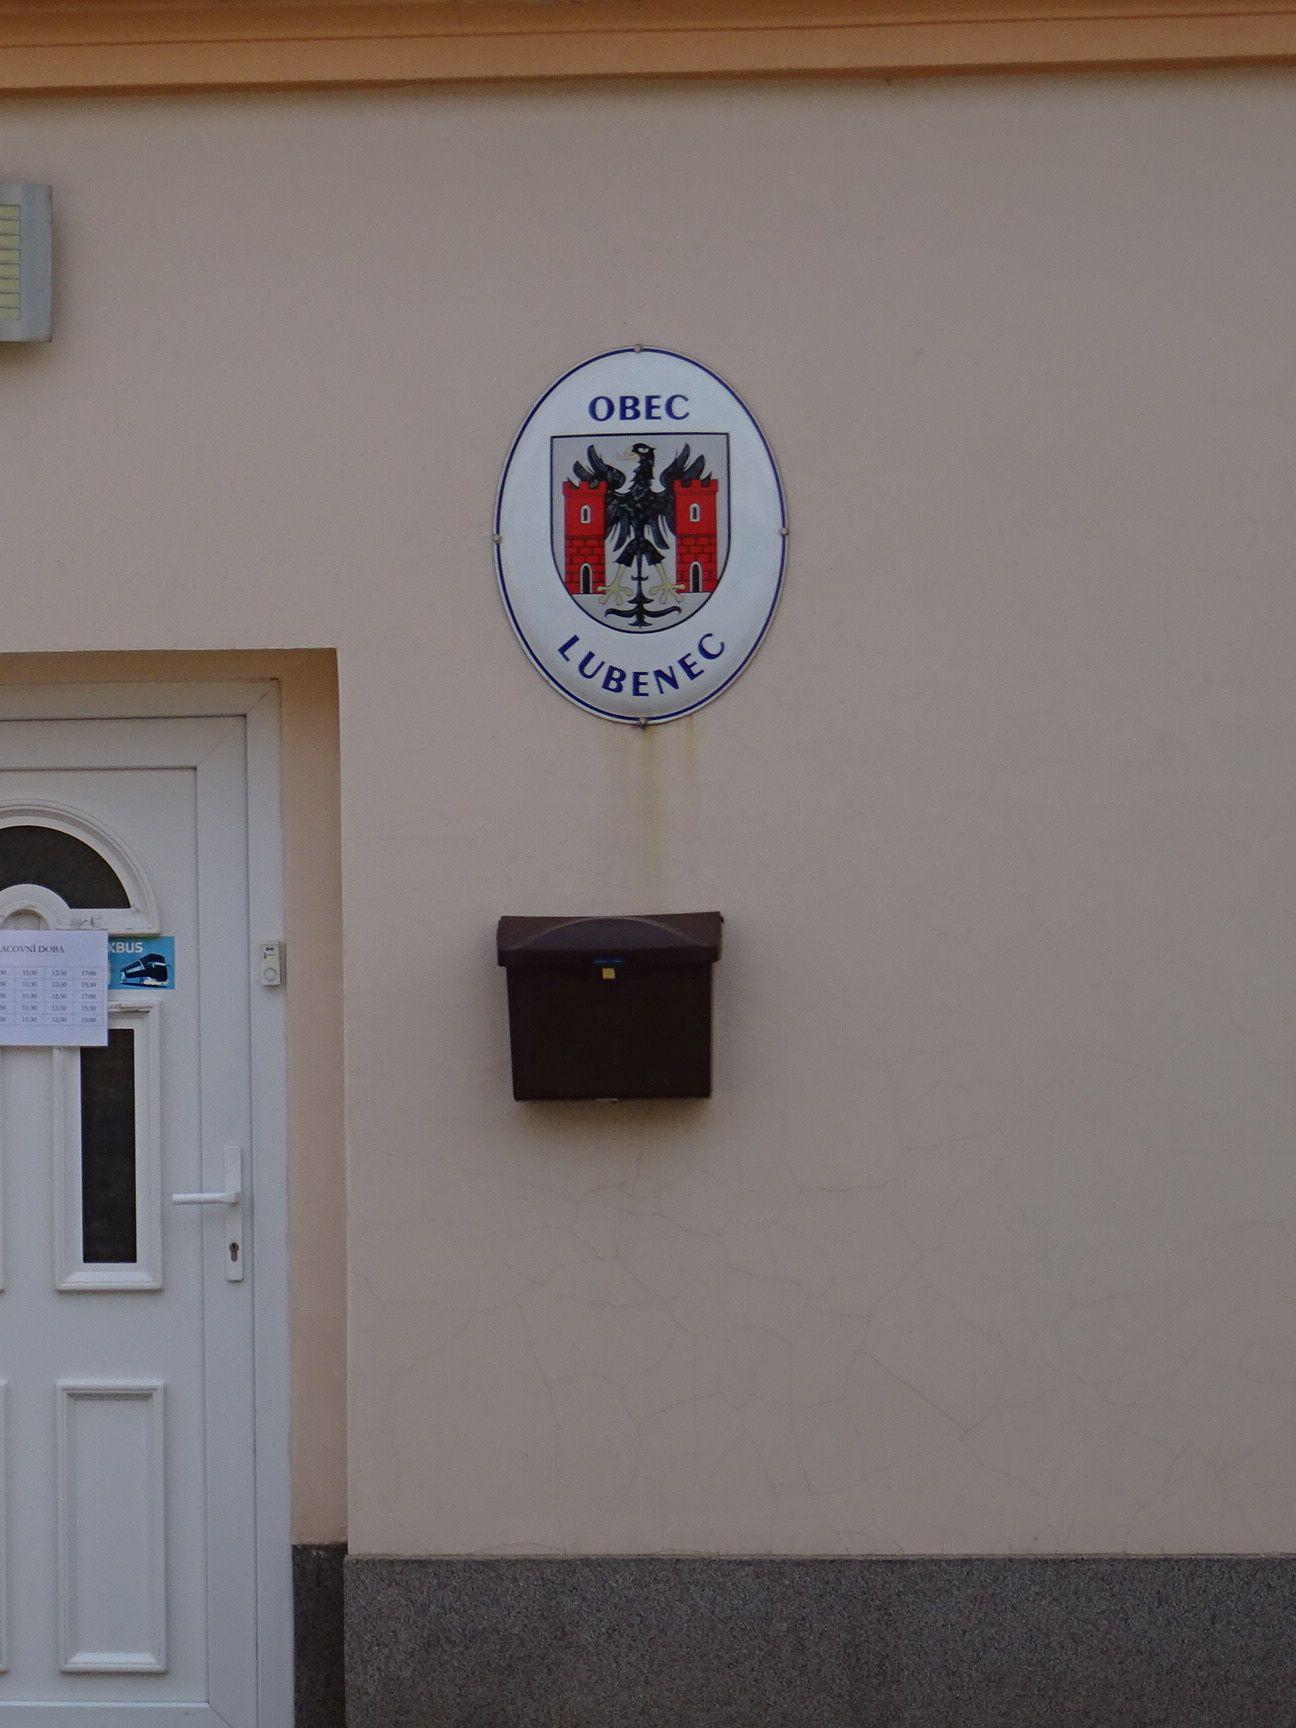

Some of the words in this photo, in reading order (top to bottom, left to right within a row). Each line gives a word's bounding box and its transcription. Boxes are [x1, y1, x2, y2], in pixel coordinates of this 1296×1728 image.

[588, 394, 690, 422] OBEC
[557, 632, 725, 697] LUBENEC
[38, 945, 65, 954] DOBA
